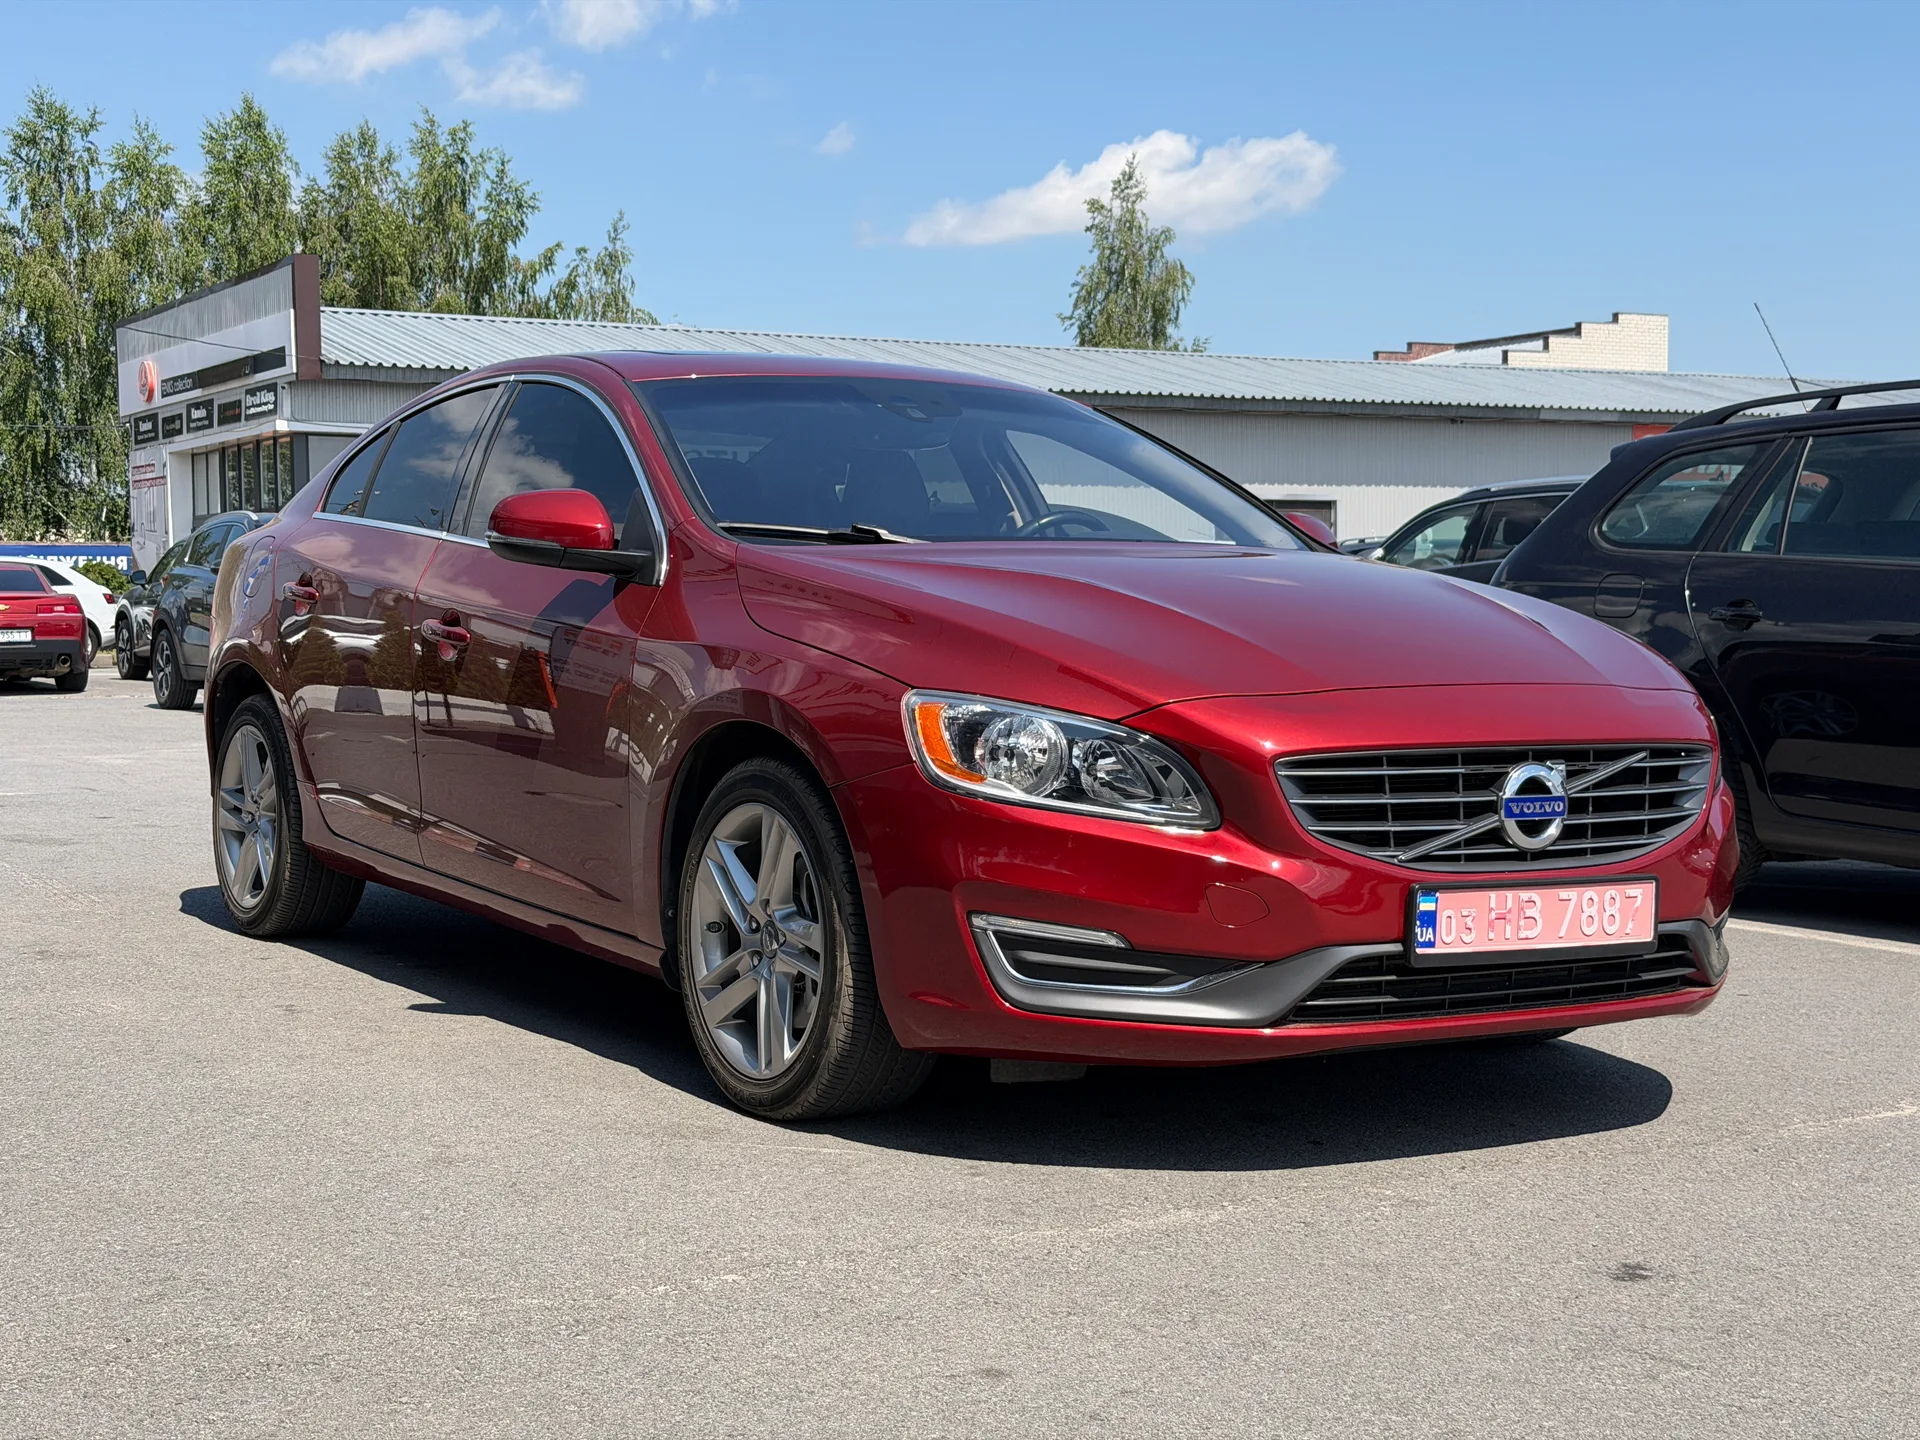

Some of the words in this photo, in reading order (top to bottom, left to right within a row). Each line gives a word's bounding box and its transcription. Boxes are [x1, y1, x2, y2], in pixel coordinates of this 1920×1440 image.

[1508, 800, 1564, 814] VOLVO
[1440, 908, 1476, 944] 03
[1488, 892, 1543, 941] HB
[1558, 888, 1643, 938] 7887
[1417, 927, 1434, 943] UA
